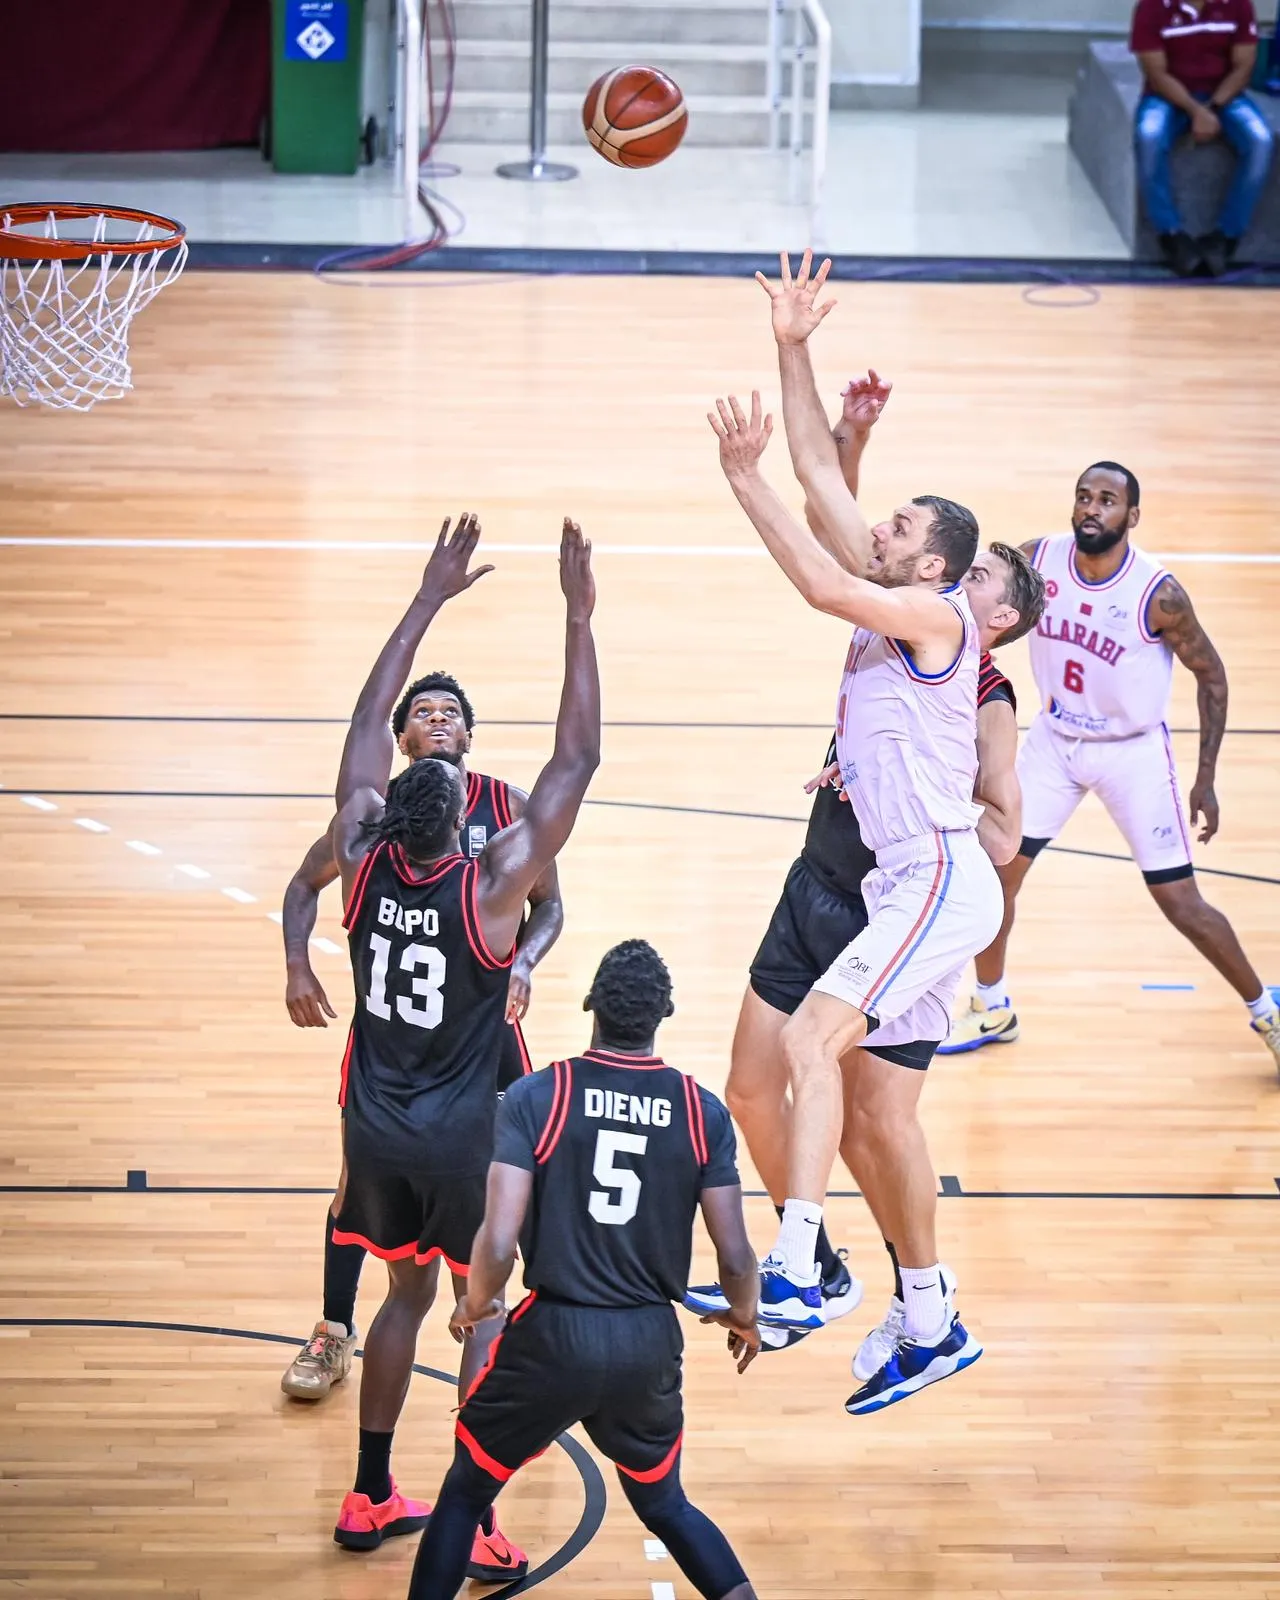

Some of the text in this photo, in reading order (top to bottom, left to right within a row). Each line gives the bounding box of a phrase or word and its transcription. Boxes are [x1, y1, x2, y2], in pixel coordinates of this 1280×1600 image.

[1063, 659, 1085, 694] 6
[366, 932, 447, 1030] 13
[584, 1088, 672, 1128] DIENG
[588, 1129, 649, 1226] 5
